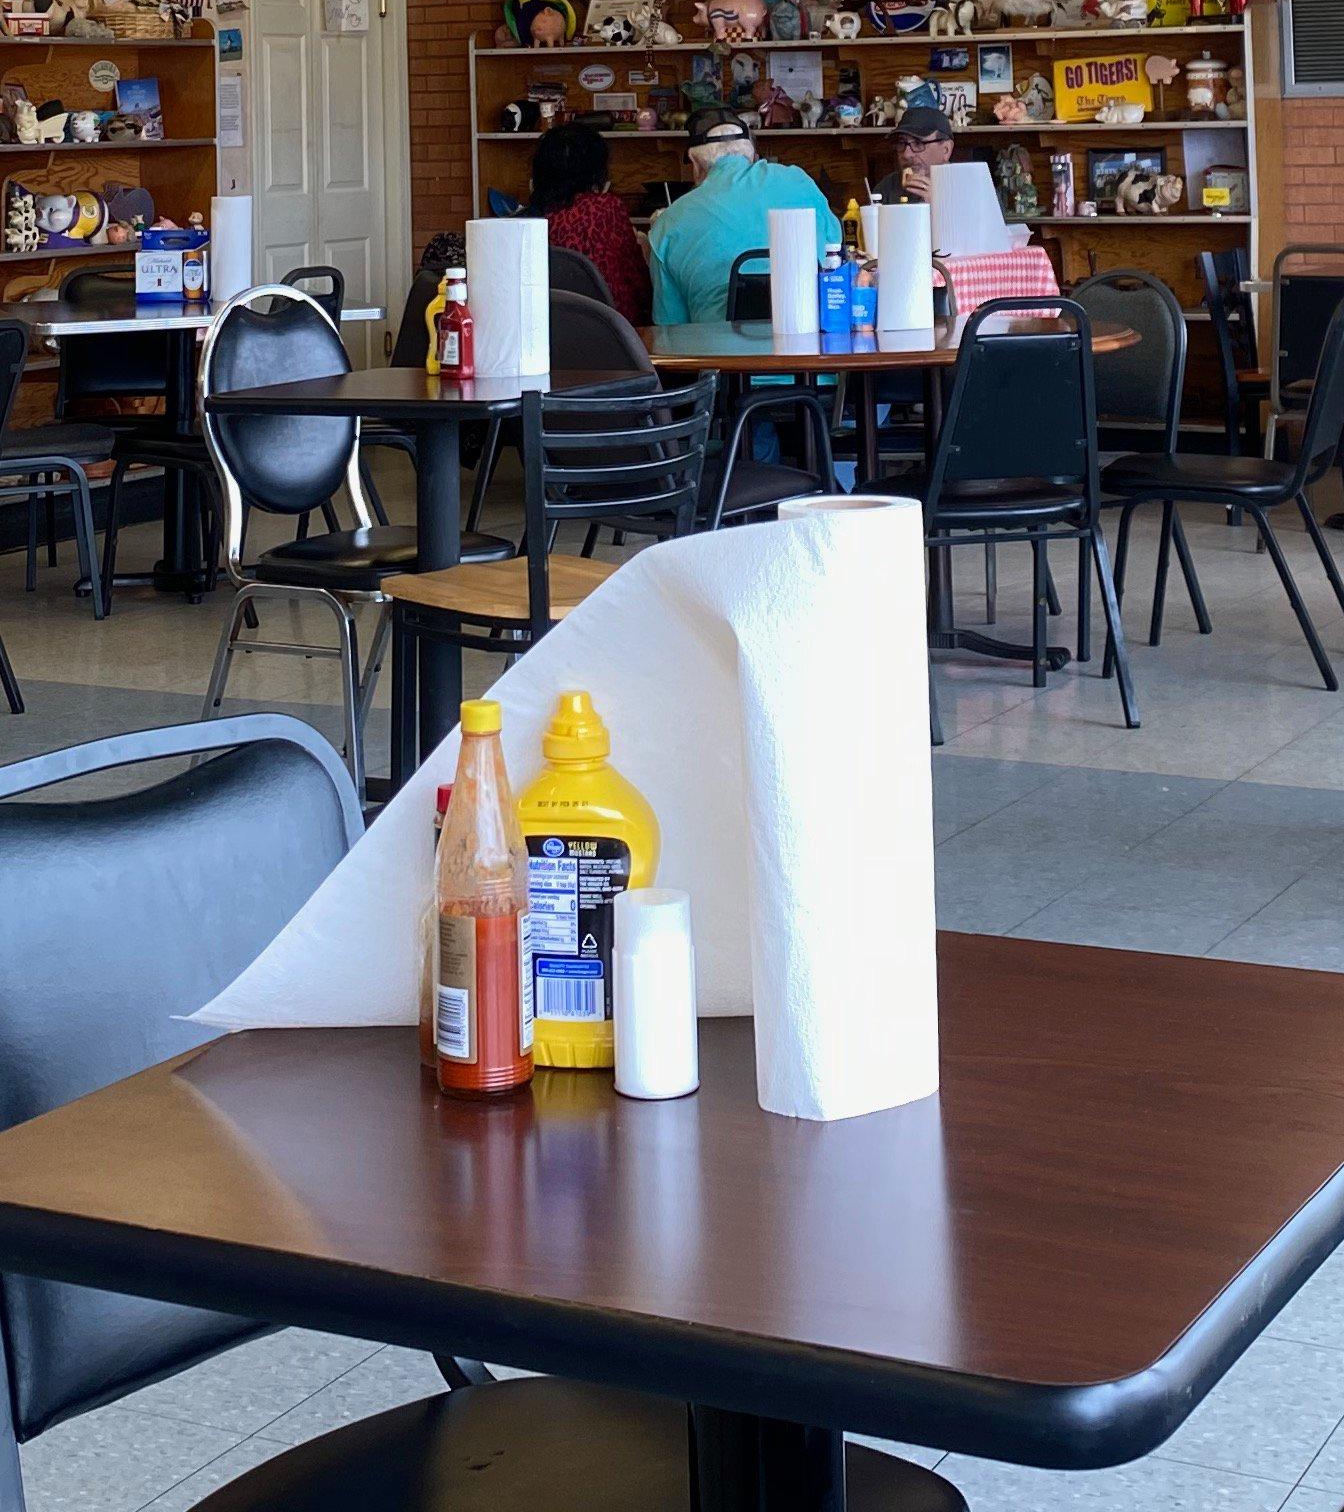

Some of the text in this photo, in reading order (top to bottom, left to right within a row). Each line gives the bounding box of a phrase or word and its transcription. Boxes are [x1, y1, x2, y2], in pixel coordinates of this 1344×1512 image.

[1065, 58, 1139, 88] GO TIGERS!
[141, 264, 178, 274] ULTRA
[568, 841, 598, 850] YELLOW
[558, 860, 576, 871] Facts
[570, 899, 576, 911] 0
